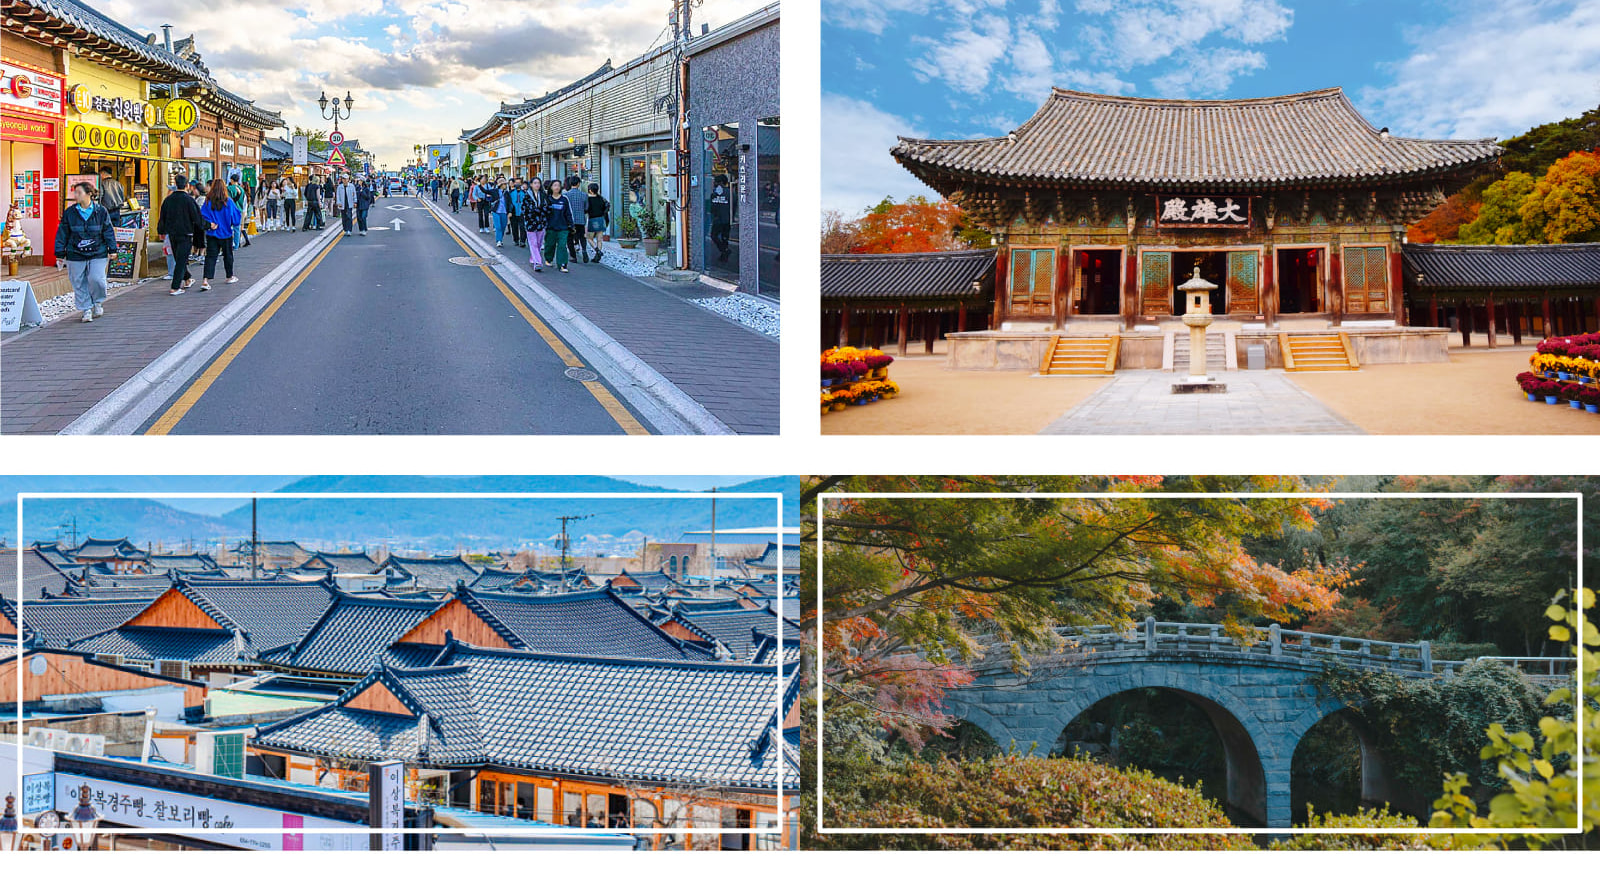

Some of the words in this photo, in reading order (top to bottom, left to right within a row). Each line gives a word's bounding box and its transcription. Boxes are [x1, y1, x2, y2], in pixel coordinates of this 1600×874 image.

[94, 95, 112, 112] 경주
[112, 97, 143, 124] 십원빵
[178, 105, 193, 125] 10
[1, 120, 28, 131] yeongju
[30, 124, 46, 133] world
